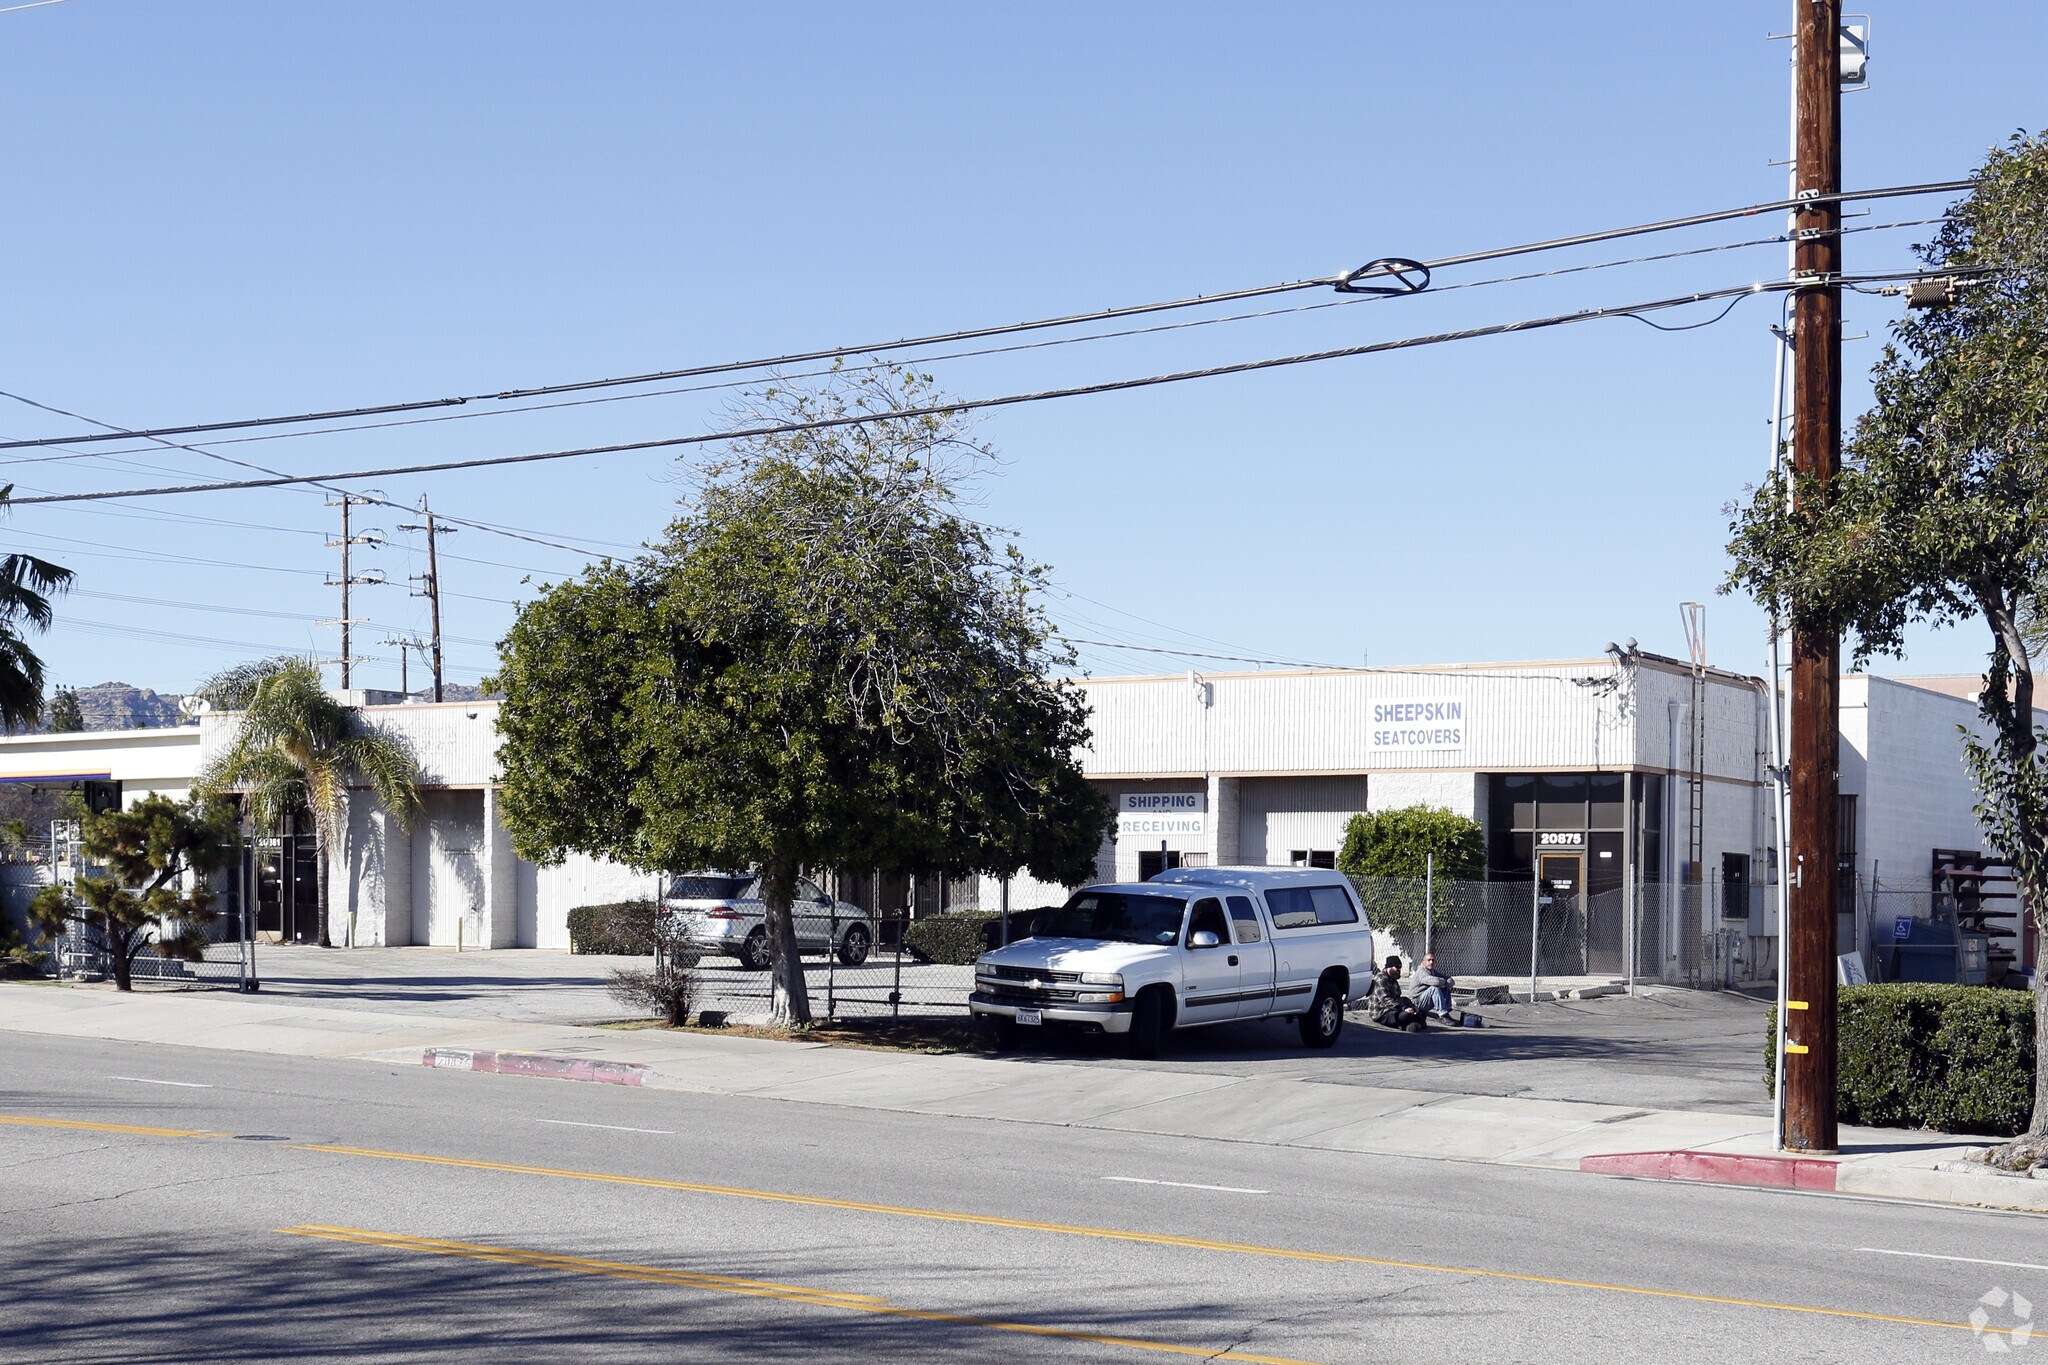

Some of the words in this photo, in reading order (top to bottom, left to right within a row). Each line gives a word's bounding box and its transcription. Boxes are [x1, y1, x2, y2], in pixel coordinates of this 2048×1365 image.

[1374, 702, 1461, 723] SHEEPSKIN
[1374, 728, 1461, 746] SEATCOVERS
[1128, 795, 1196, 808] SHIPPING
[1151, 809, 1172, 818] AND
[1123, 820, 1201, 832] RECEIVING
[1541, 833, 1582, 844] 20875
